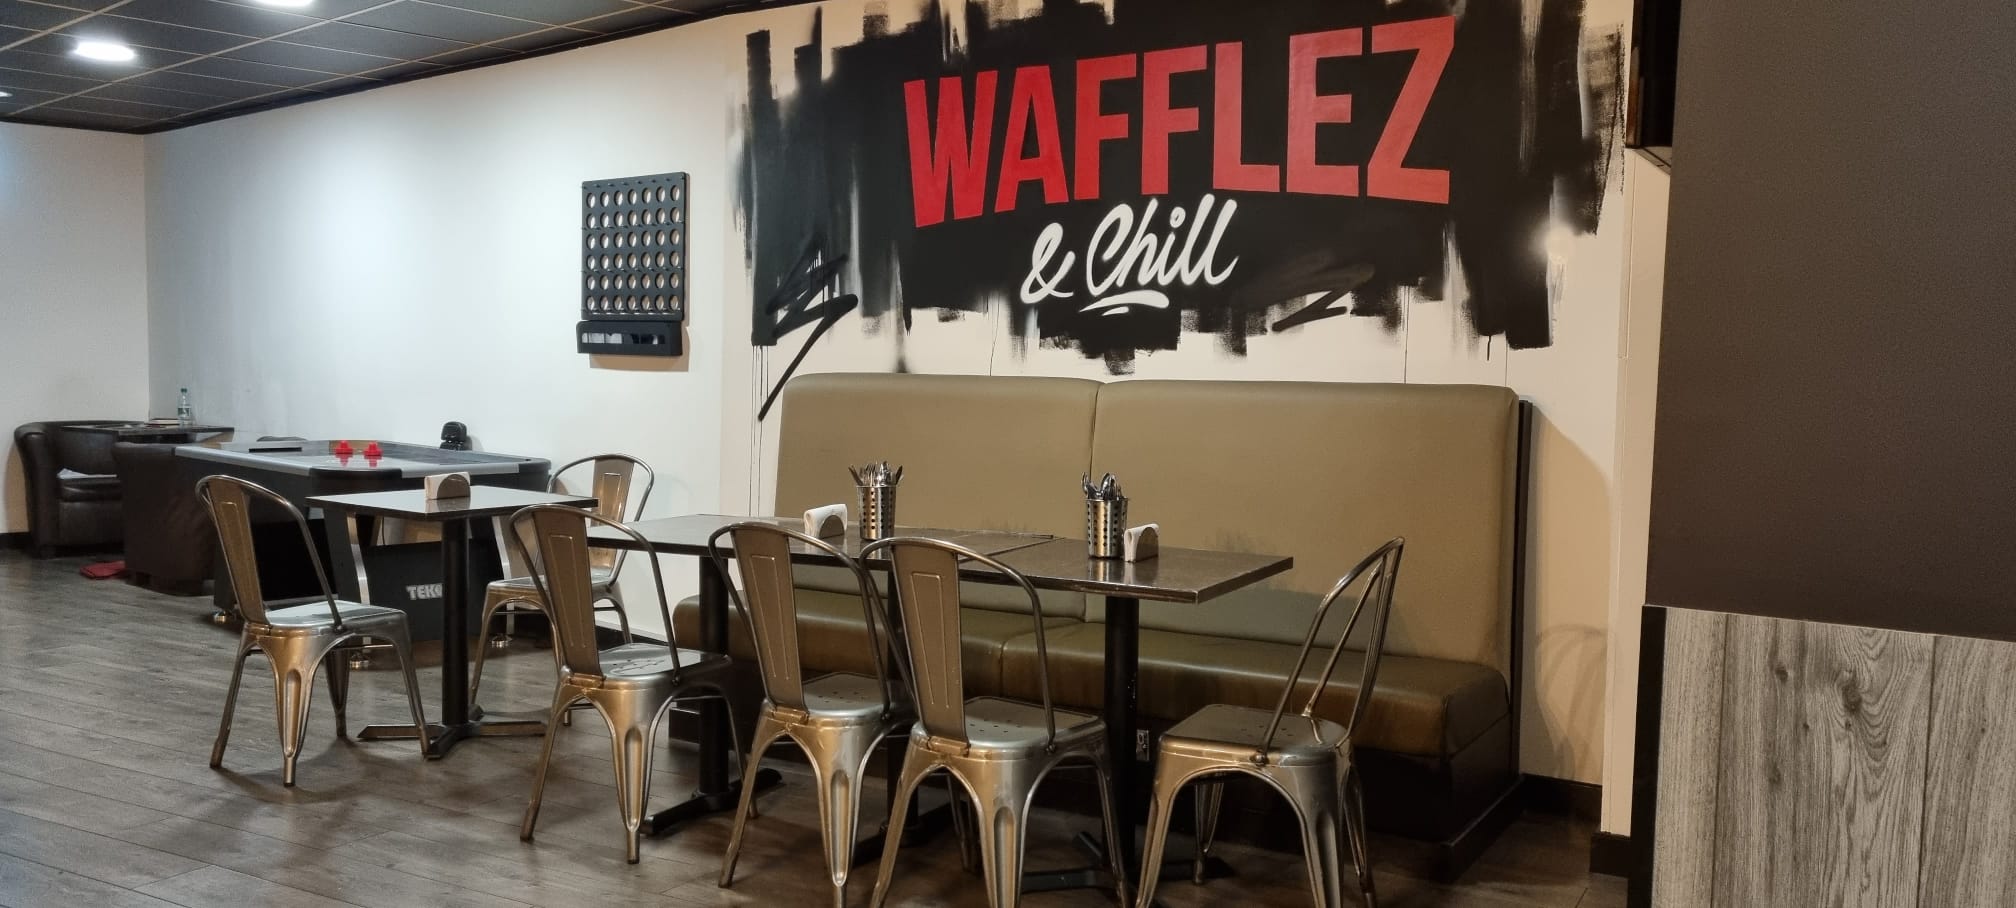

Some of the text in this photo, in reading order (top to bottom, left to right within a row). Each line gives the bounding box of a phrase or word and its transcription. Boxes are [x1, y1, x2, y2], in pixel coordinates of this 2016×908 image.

[904, 16, 1455, 227] WAFFLEZ
[1020, 193, 1239, 304] & Chill
